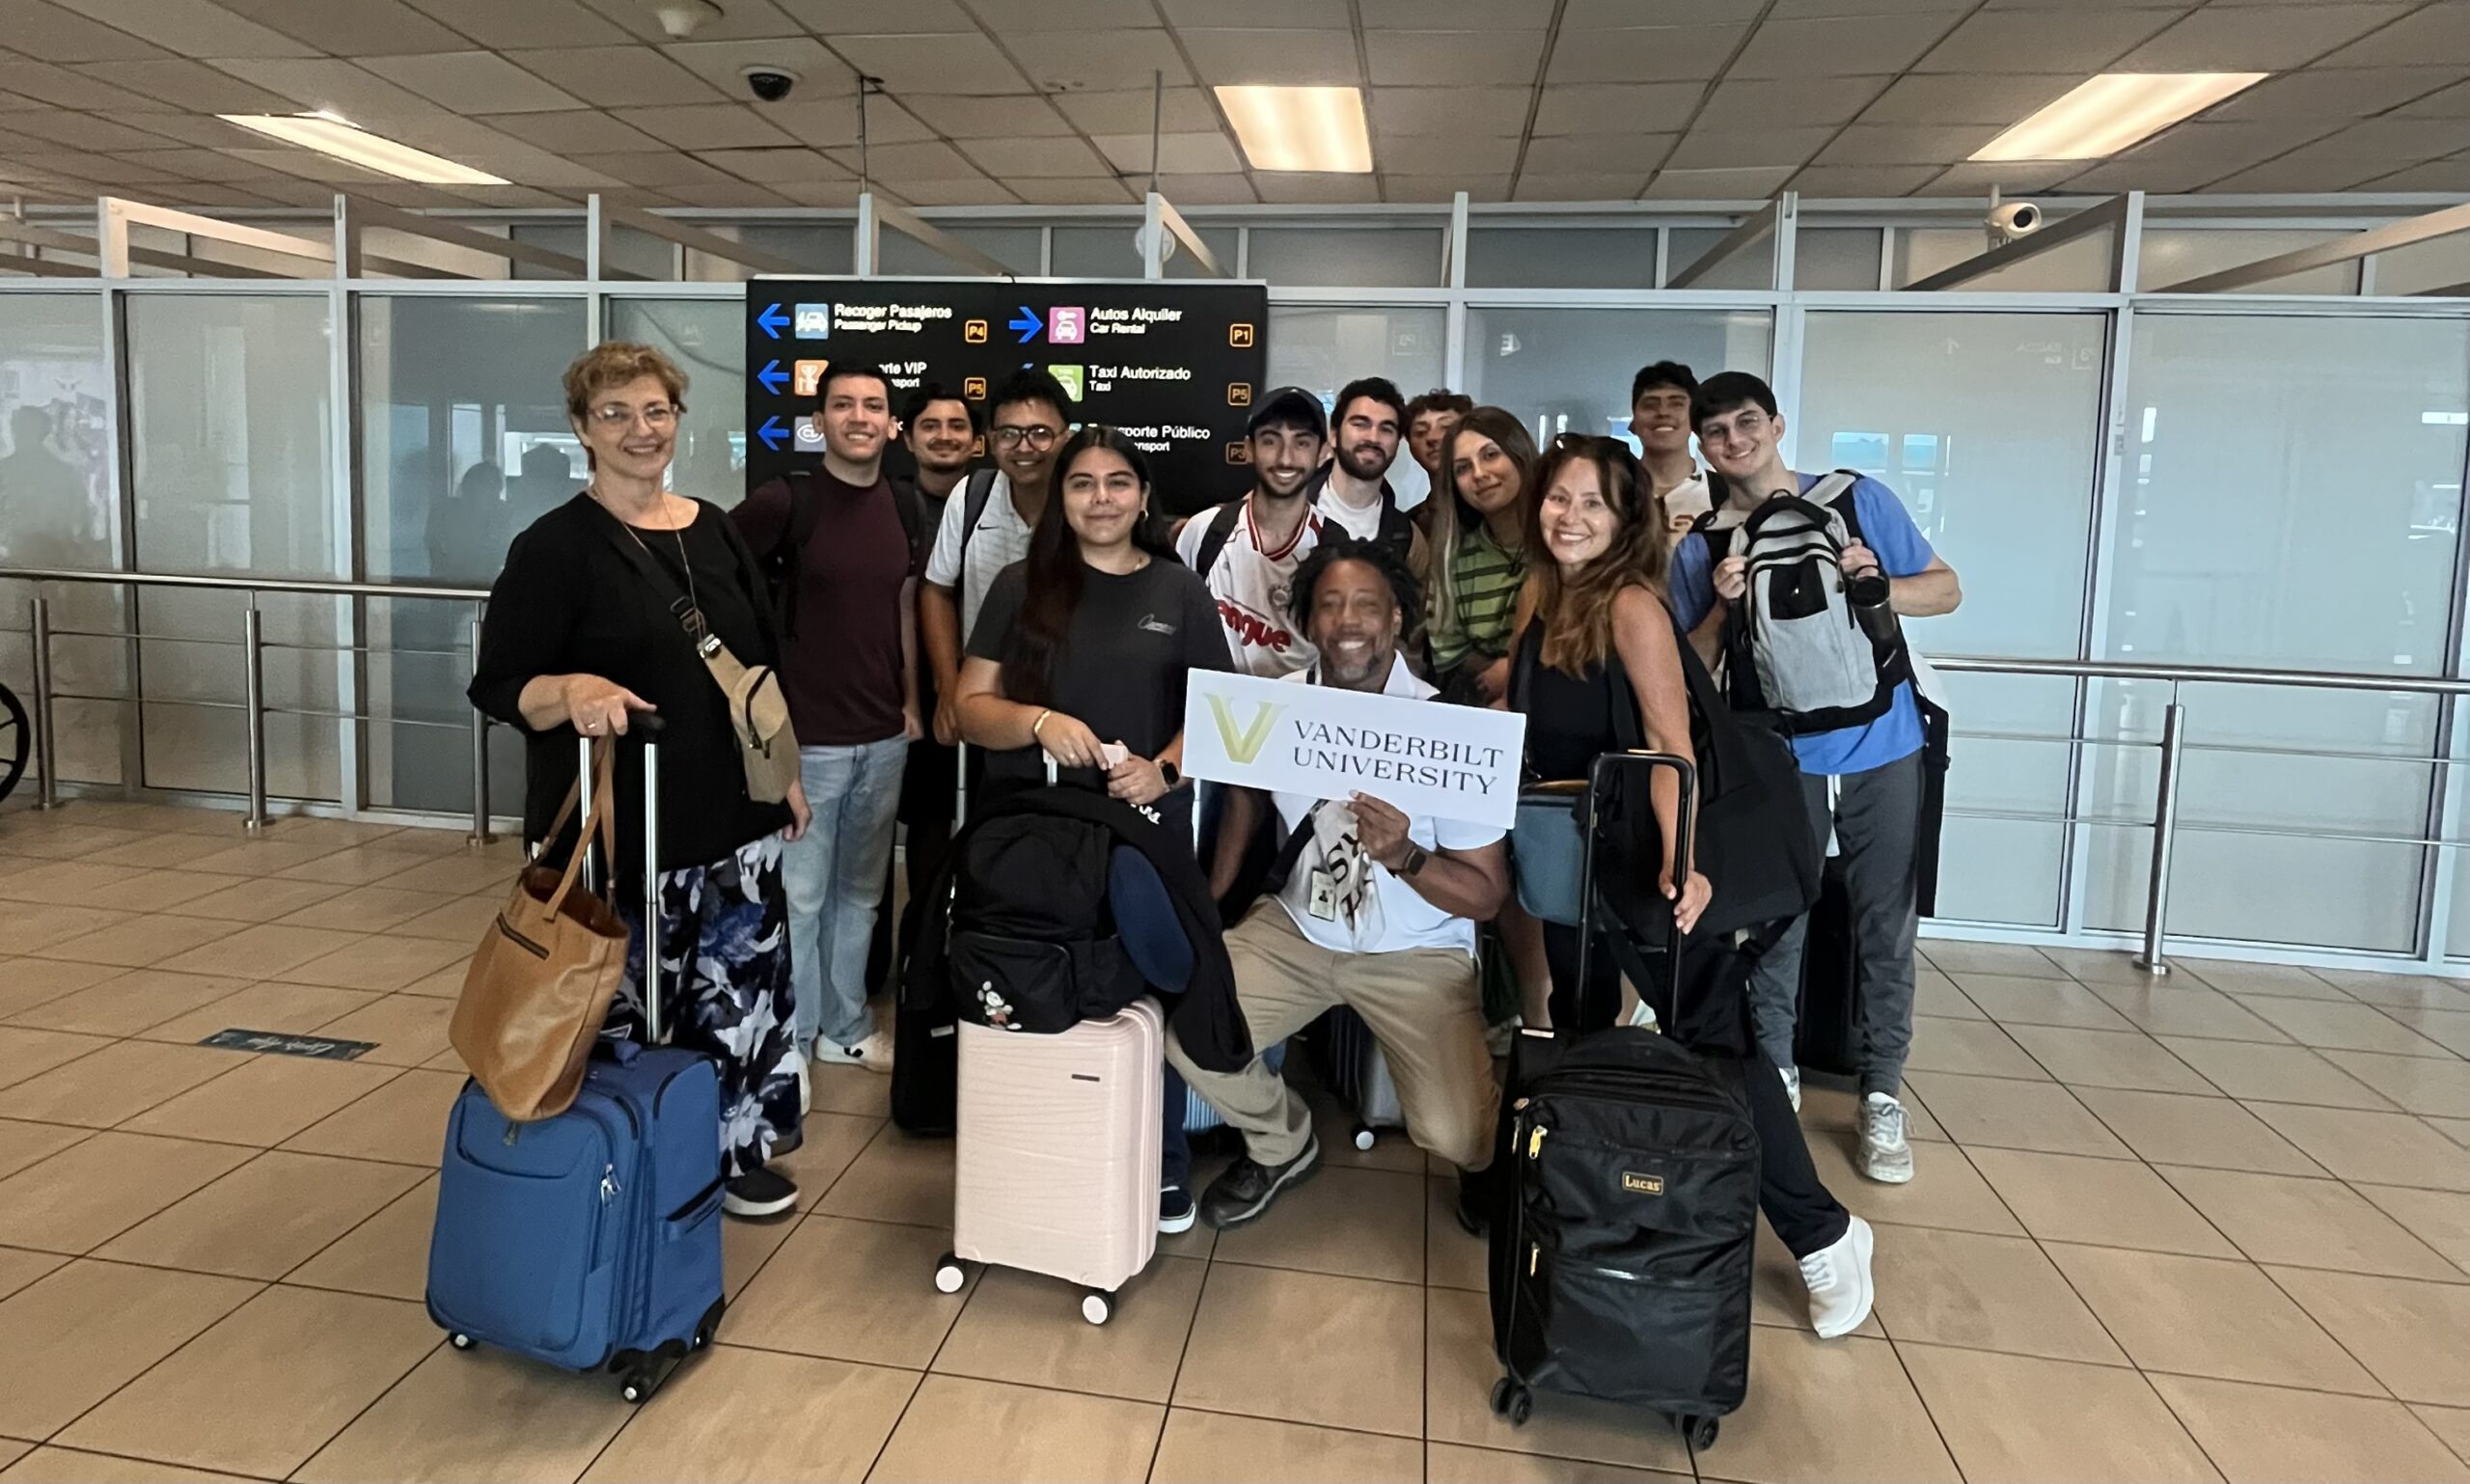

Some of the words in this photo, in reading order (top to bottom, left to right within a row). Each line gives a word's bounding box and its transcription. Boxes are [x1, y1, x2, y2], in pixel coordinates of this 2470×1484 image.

[834, 303, 888, 320] Recoger
[890, 304, 952, 320] Pasajeros
[1089, 307, 1129, 320] Autos
[1132, 308, 1182, 323] Alquiler
[969, 325, 983, 337] P4
[1089, 323, 1110, 334] Car
[1112, 323, 1145, 334] Rental
[1233, 329, 1249, 342] P1
[904, 362, 927, 374] VIP
[1089, 365, 1117, 378] Taxi
[1120, 366, 1192, 380] Autorizado
[1089, 380, 1111, 392] Taxi
[1232, 388, 1249, 400] P5
[1162, 426, 1211, 439] Público
[1294, 720, 1503, 769] VANDERBILT
[1293, 746, 1498, 795] UNIVERSITY
[1625, 1175, 1661, 1192] Lucas
